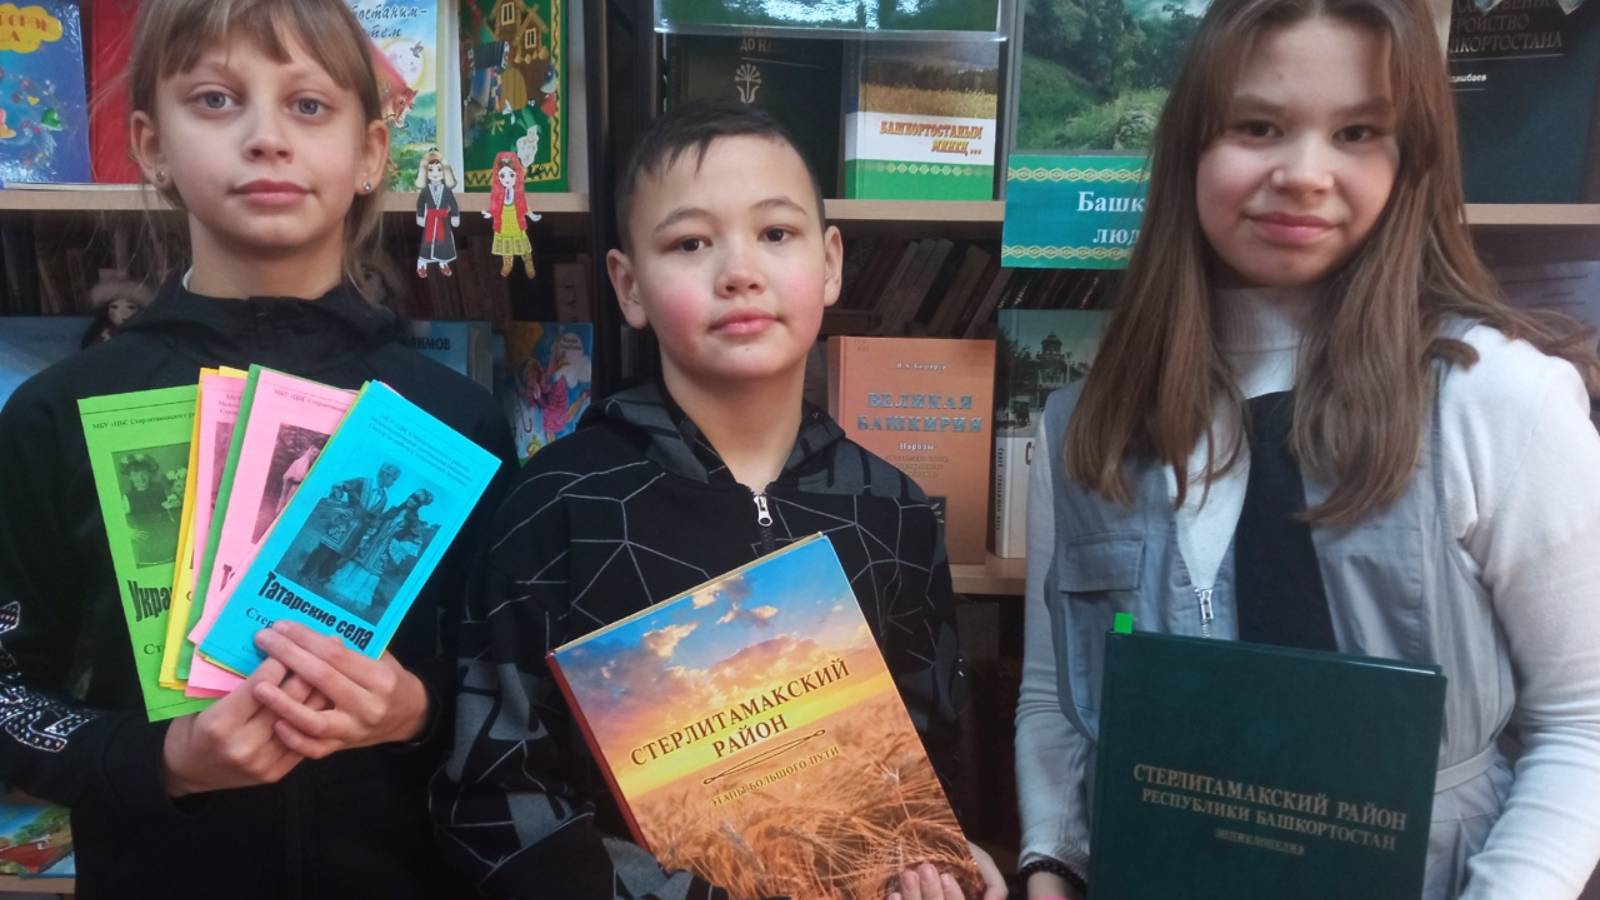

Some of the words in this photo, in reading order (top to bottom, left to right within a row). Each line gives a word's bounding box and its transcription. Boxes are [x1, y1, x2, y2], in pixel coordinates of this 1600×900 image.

[1077, 190, 1146, 213] Башк
[857, 414, 983, 433] БАШКИРИЯ
[867, 392, 974, 410] ВЕЛИКАЯ
[127, 579, 173, 622] Укра
[258, 570, 337, 628] Татарские
[335, 619, 375, 652] села
[630, 657, 851, 767] СТЕРЛИТАМАКСКИЙ
[712, 713, 789, 759] РАЙОН
[748, 759, 808, 791] БОЛЬШОГО
[807, 745, 840, 767] ПУТИ
[1133, 763, 1329, 816] СТЕРЛИТАМАКСКИЙ
[1336, 801, 1408, 831] РАЙОН
[1142, 787, 1250, 822] РЕСПУБЛИКИ
[1255, 810, 1396, 851] БАШКОРТОСТАН
